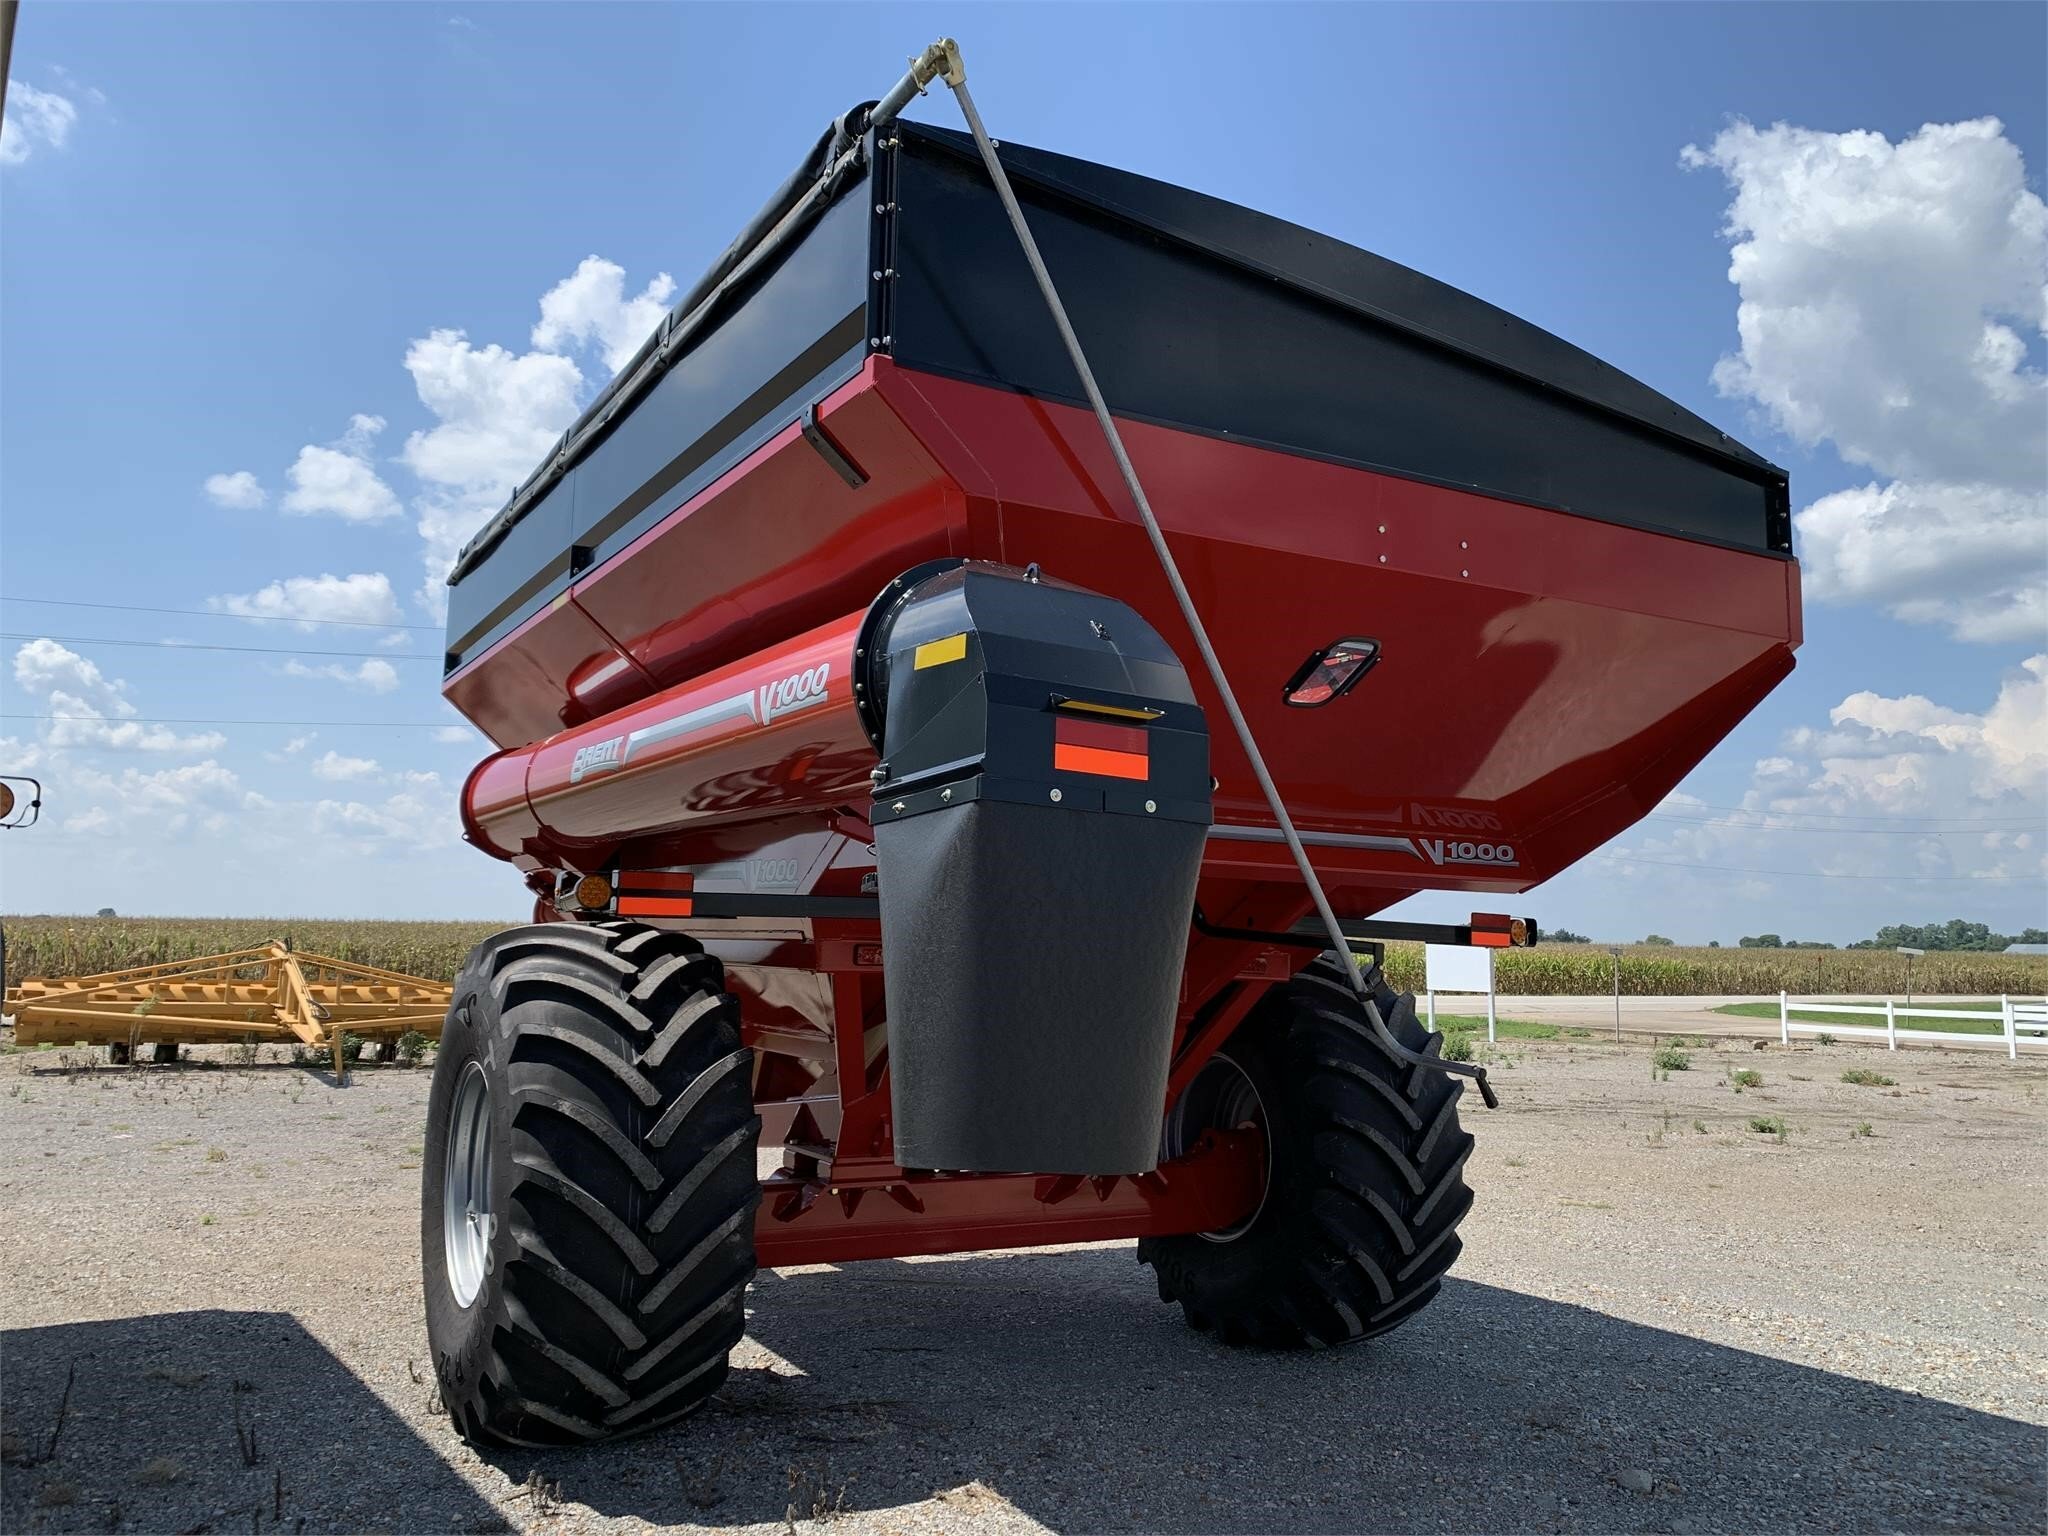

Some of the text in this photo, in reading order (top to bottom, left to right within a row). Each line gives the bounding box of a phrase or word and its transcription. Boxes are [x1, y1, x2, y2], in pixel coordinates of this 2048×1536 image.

[570, 663, 830, 783] BRENT V1000
[1418, 838, 1515, 866] V1000
[750, 857, 799, 892] V1000
